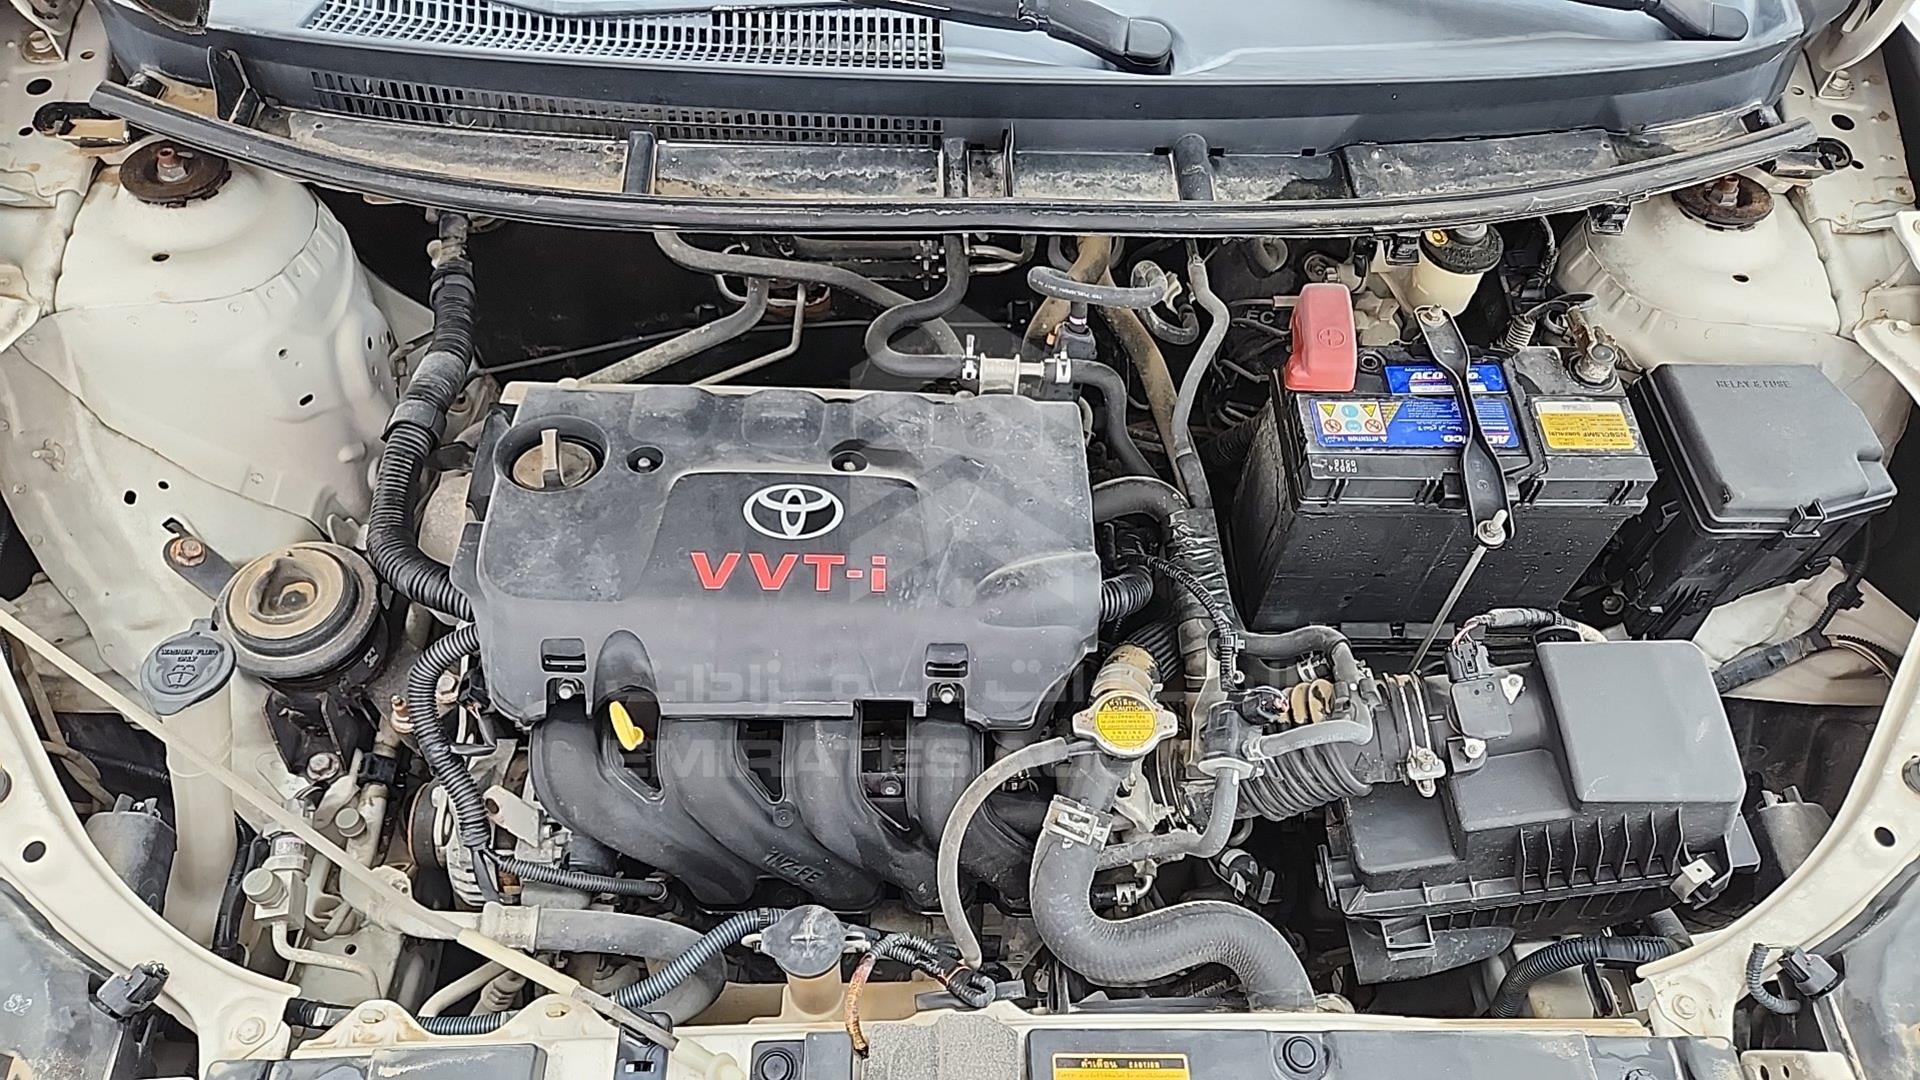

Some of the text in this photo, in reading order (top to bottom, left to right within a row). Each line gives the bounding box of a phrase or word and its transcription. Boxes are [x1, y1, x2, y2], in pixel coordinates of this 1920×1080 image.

[1716, 380, 1750, 388] RELAY
[690, 551, 888, 593] VVT-i
[1128, 1060, 1161, 1069] CAUTION
